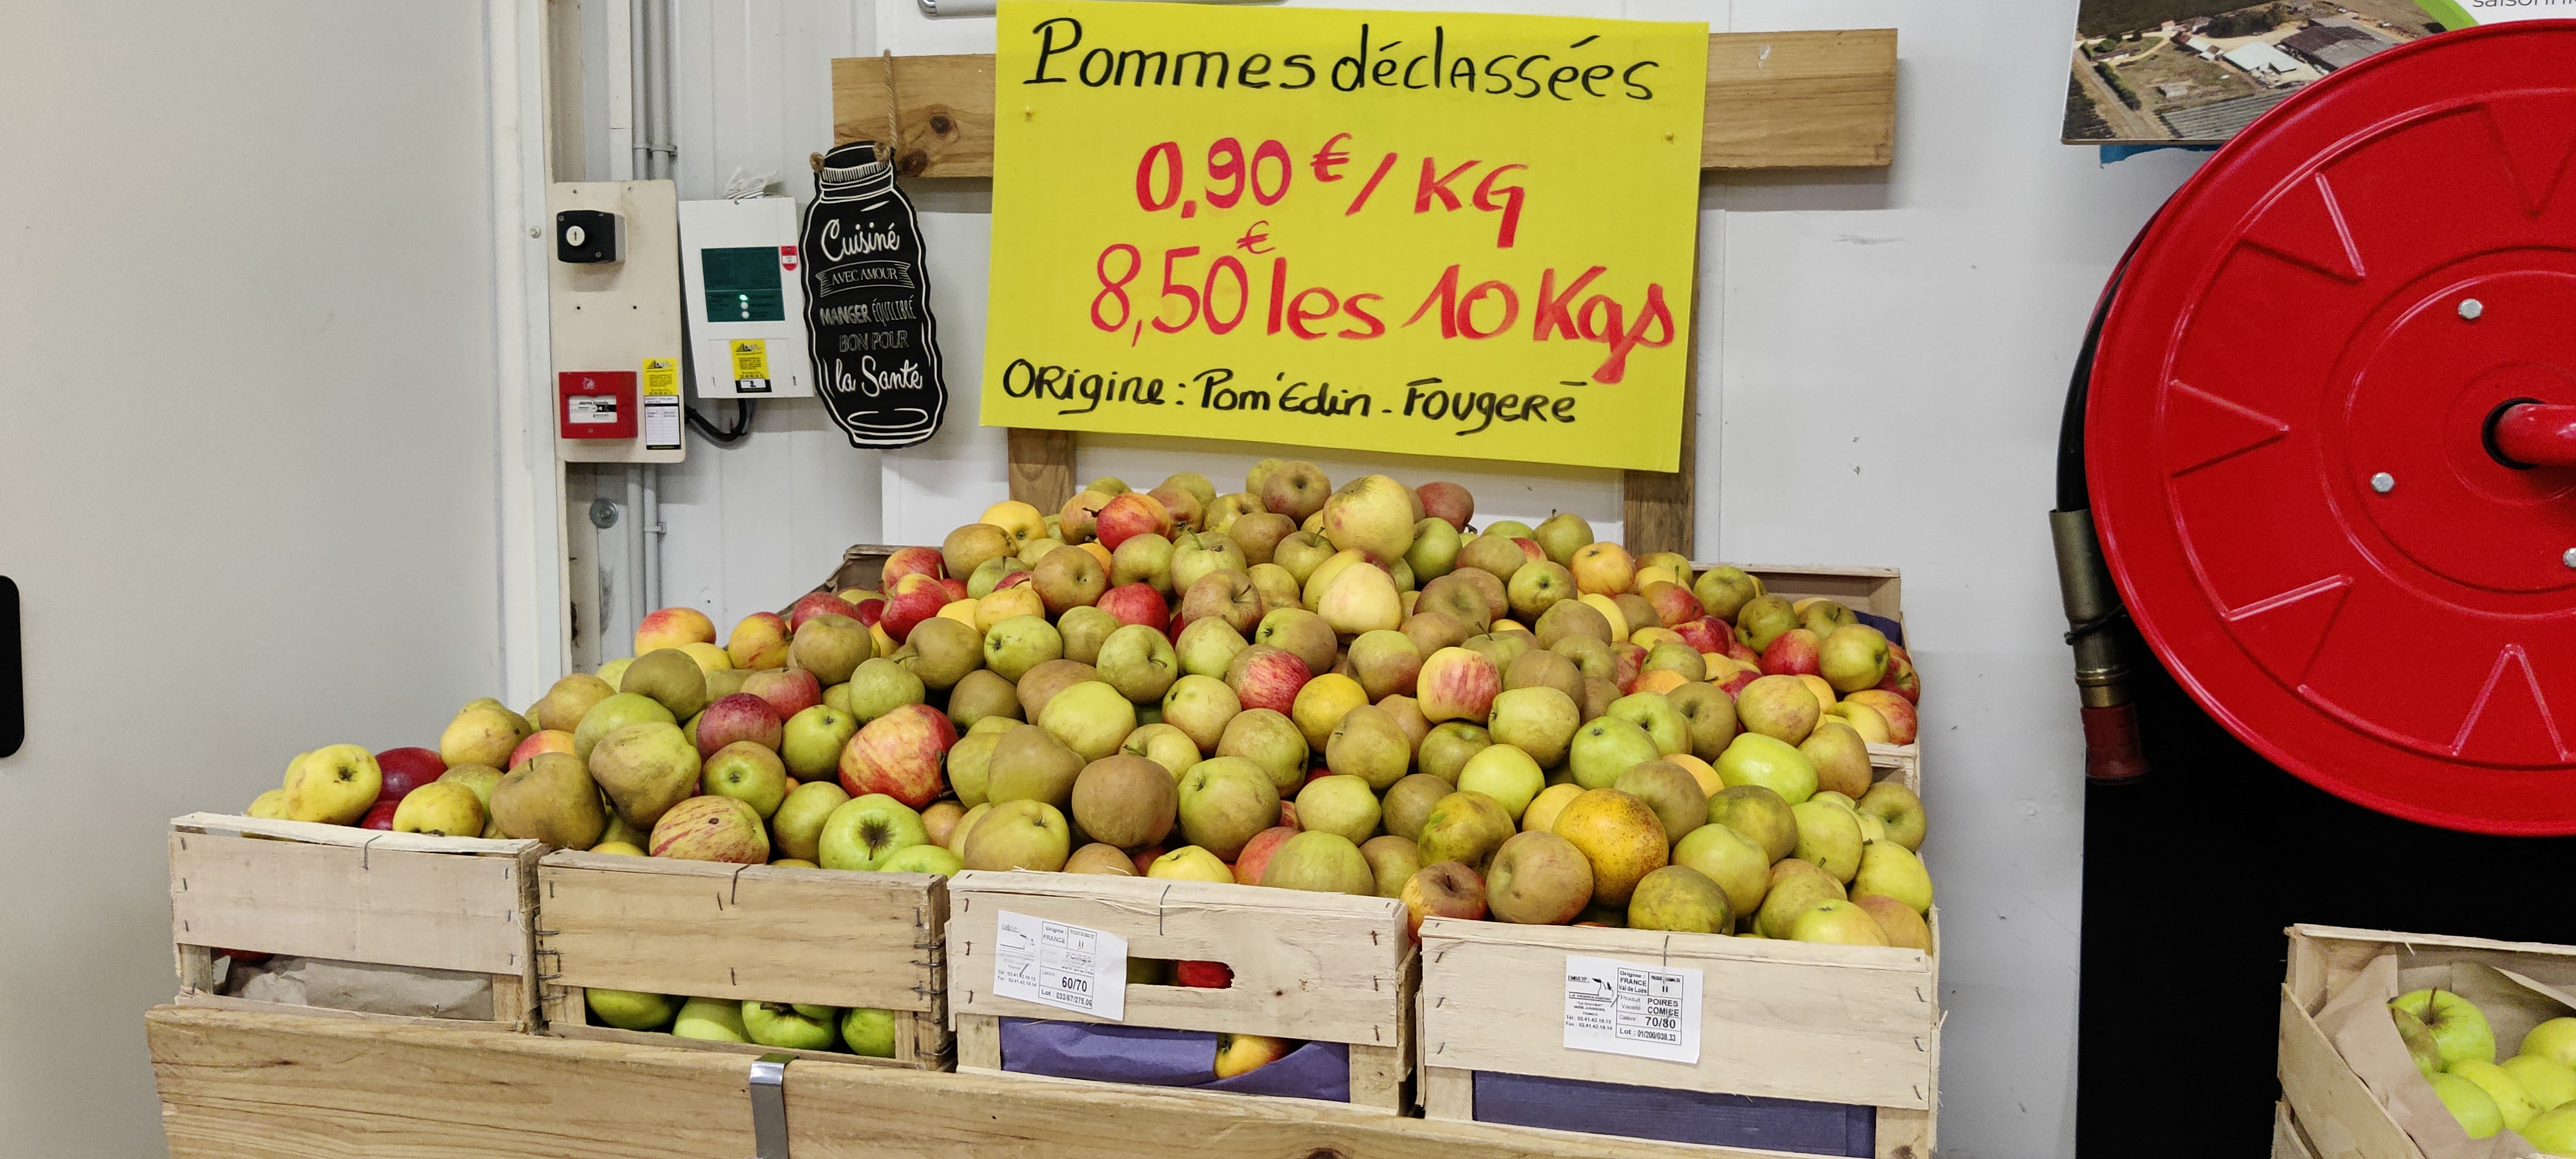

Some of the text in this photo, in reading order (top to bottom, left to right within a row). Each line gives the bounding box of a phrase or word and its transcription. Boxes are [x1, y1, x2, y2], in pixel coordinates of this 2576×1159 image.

[1022, 17, 1316, 88] Pommes
[821, 219, 900, 261] Cuisiné
[832, 267, 898, 285] AVEC AMOUR
[1267, 256, 1385, 341] les
[1400, 264, 1519, 339] 10
[820, 294, 917, 326] MANGER ÉQUILIBRÉ
[839, 330, 910, 352] BON POUR
[836, 355, 923, 397] la Santé
[1043, 934, 1066, 943] FRANCE
[1062, 976, 1087, 992] 60/70
[1620, 977, 1647, 986] FRANCE
[1647, 998, 1678, 1007] POIRES
[1647, 1006, 1679, 1017] COMICE
[1645, 1017, 1676, 1028] 70/80
